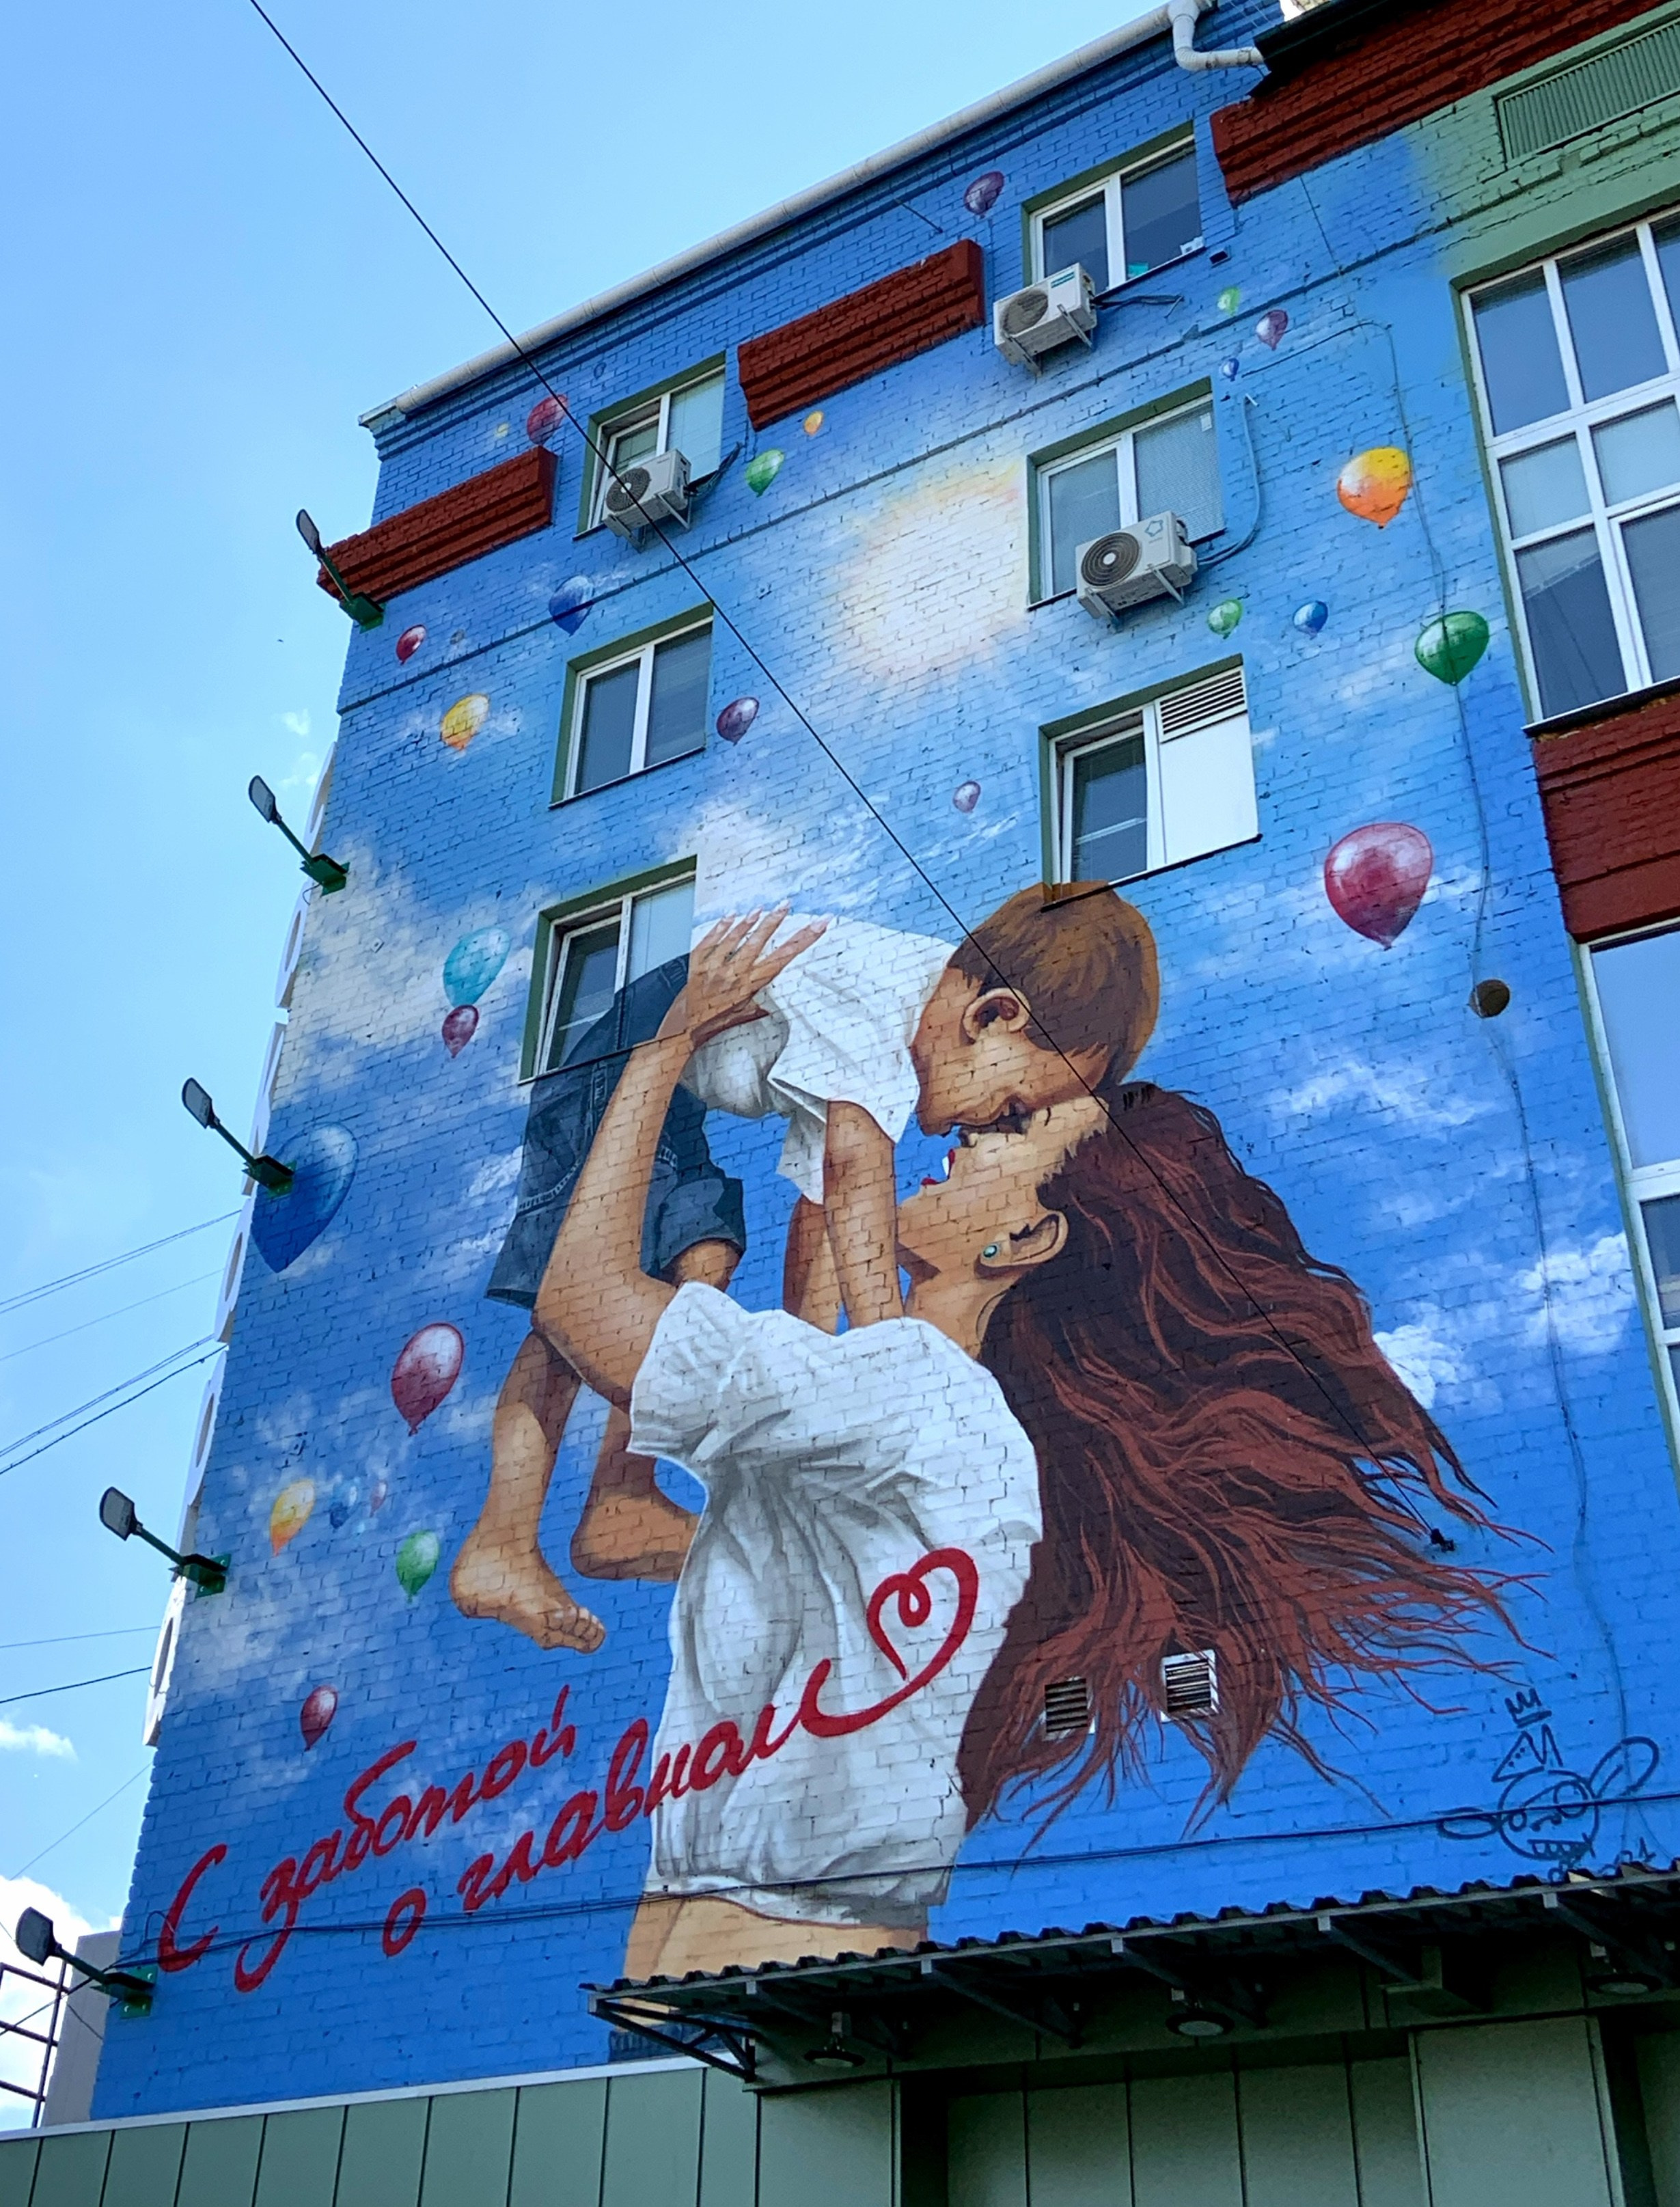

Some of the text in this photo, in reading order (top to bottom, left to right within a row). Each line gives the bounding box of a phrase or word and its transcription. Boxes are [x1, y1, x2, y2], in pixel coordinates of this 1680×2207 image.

[157, 1684, 576, 1994] С заботой
[382, 1658, 902, 1958] о главном
